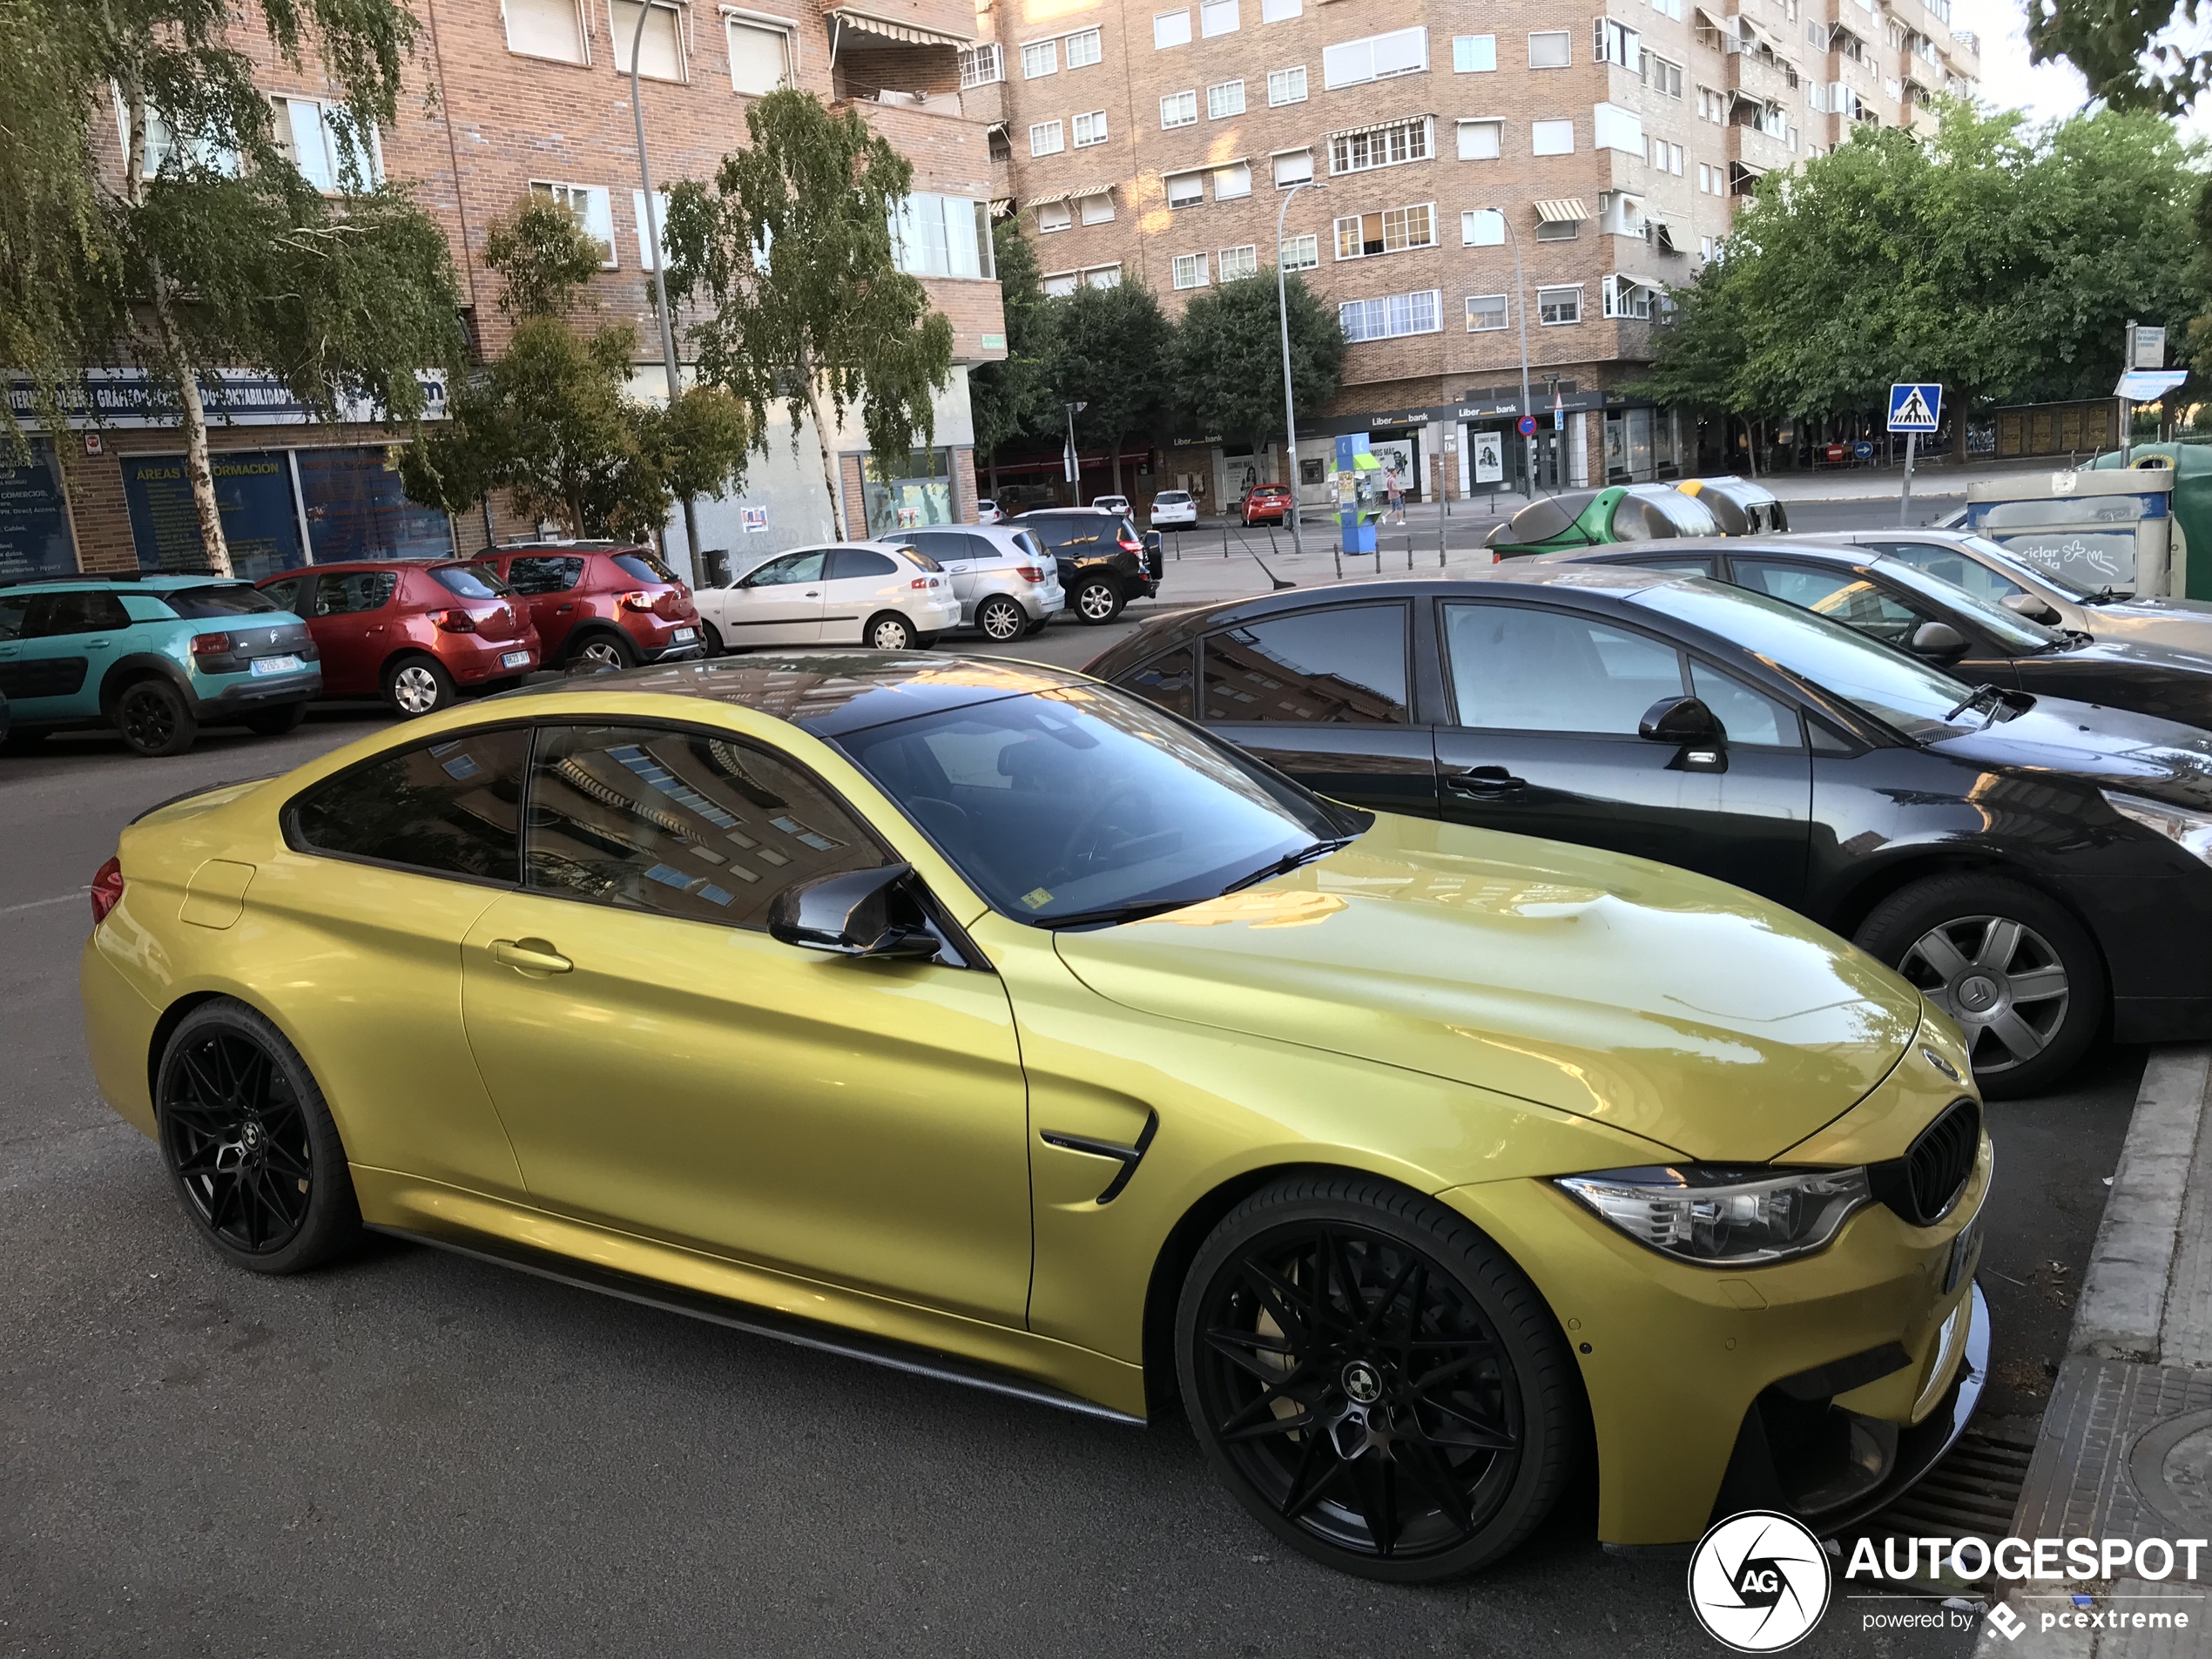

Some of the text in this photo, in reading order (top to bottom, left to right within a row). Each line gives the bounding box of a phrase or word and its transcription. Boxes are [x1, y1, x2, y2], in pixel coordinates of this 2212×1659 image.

[1459, 403, 1517, 417] Liber bank
[1372, 412, 1428, 426] Liber bank
[1173, 434, 1223, 447] Liber bank
[137, 467, 180, 481] ÁREAS
[212, 462, 280, 476] ORMACIÓN
